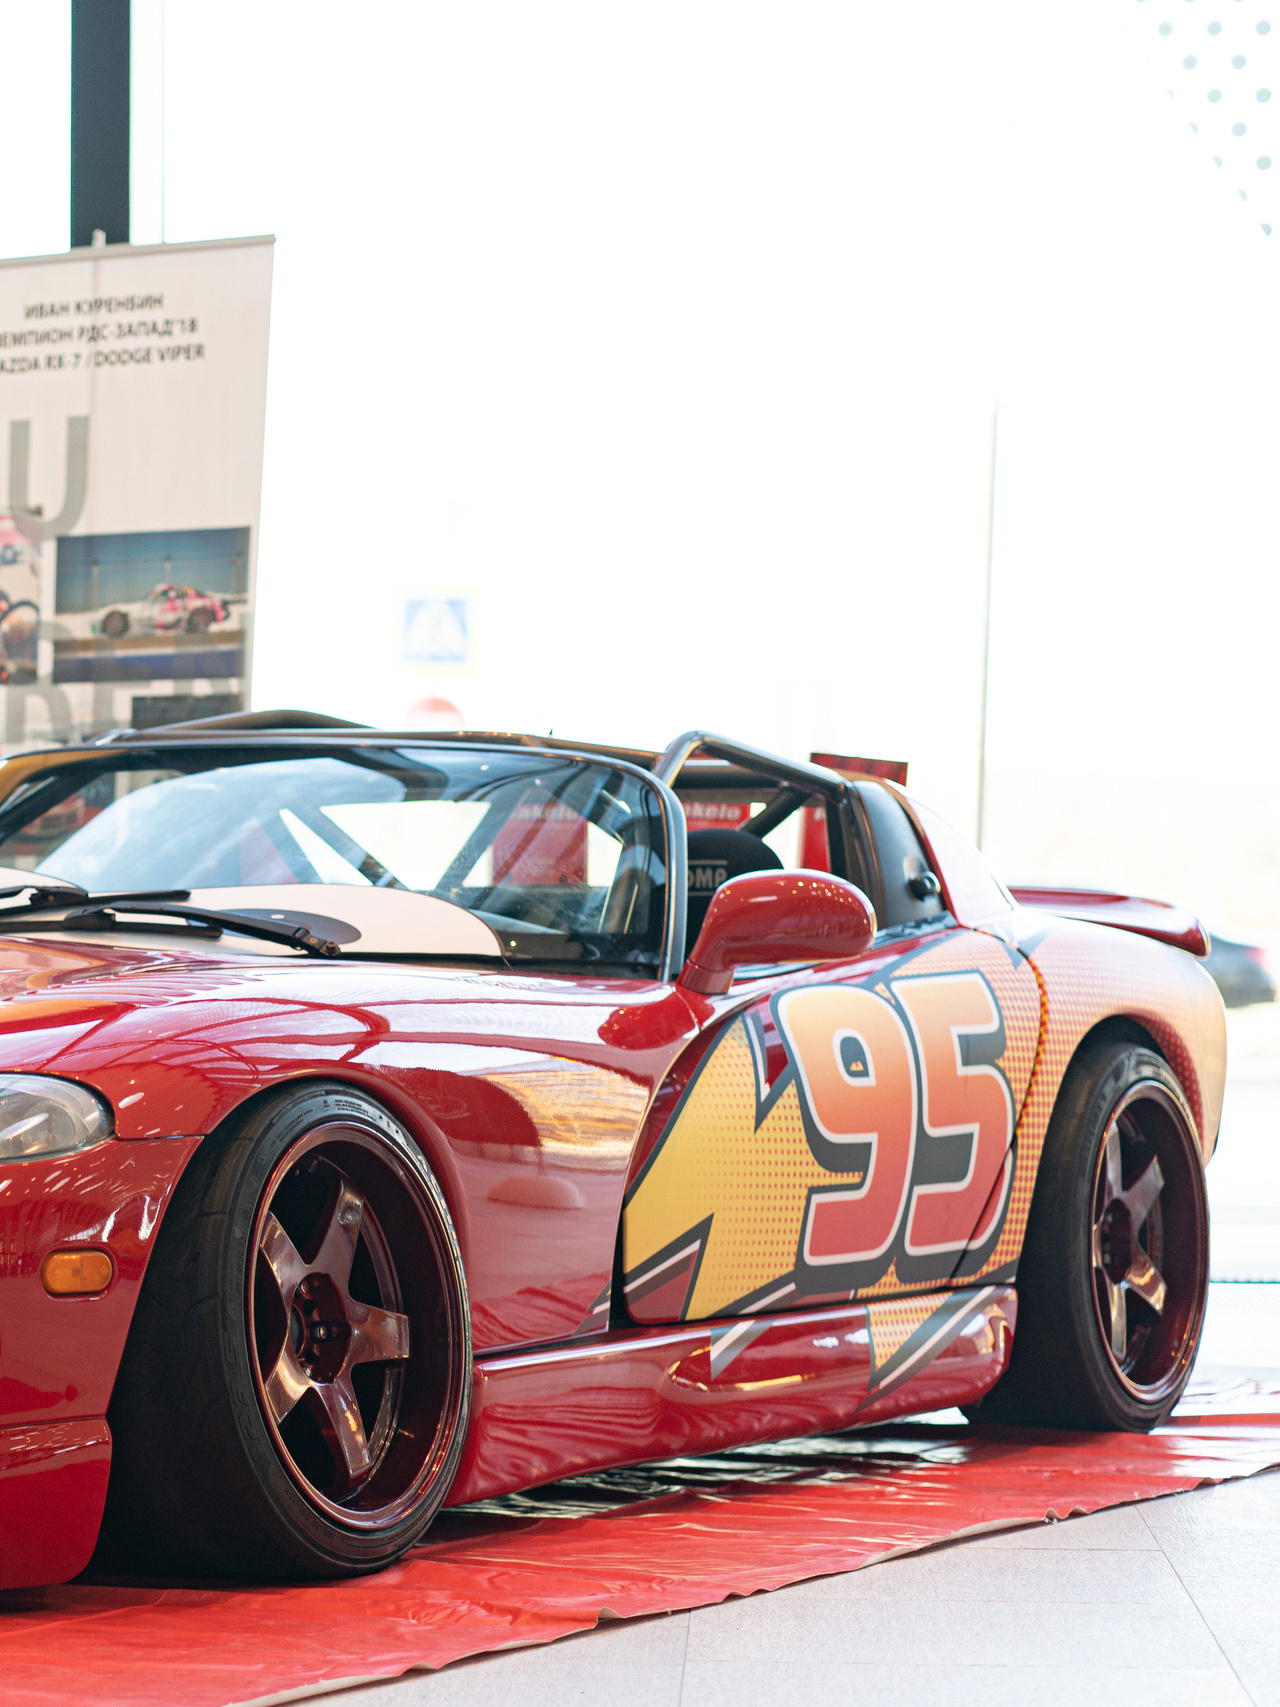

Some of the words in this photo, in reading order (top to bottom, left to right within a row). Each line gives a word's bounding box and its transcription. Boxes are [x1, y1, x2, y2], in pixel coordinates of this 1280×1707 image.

[24, 299, 70, 320] ИВАН
[157, 342, 206, 362] VIPER
[777, 971, 1014, 1266] 95
